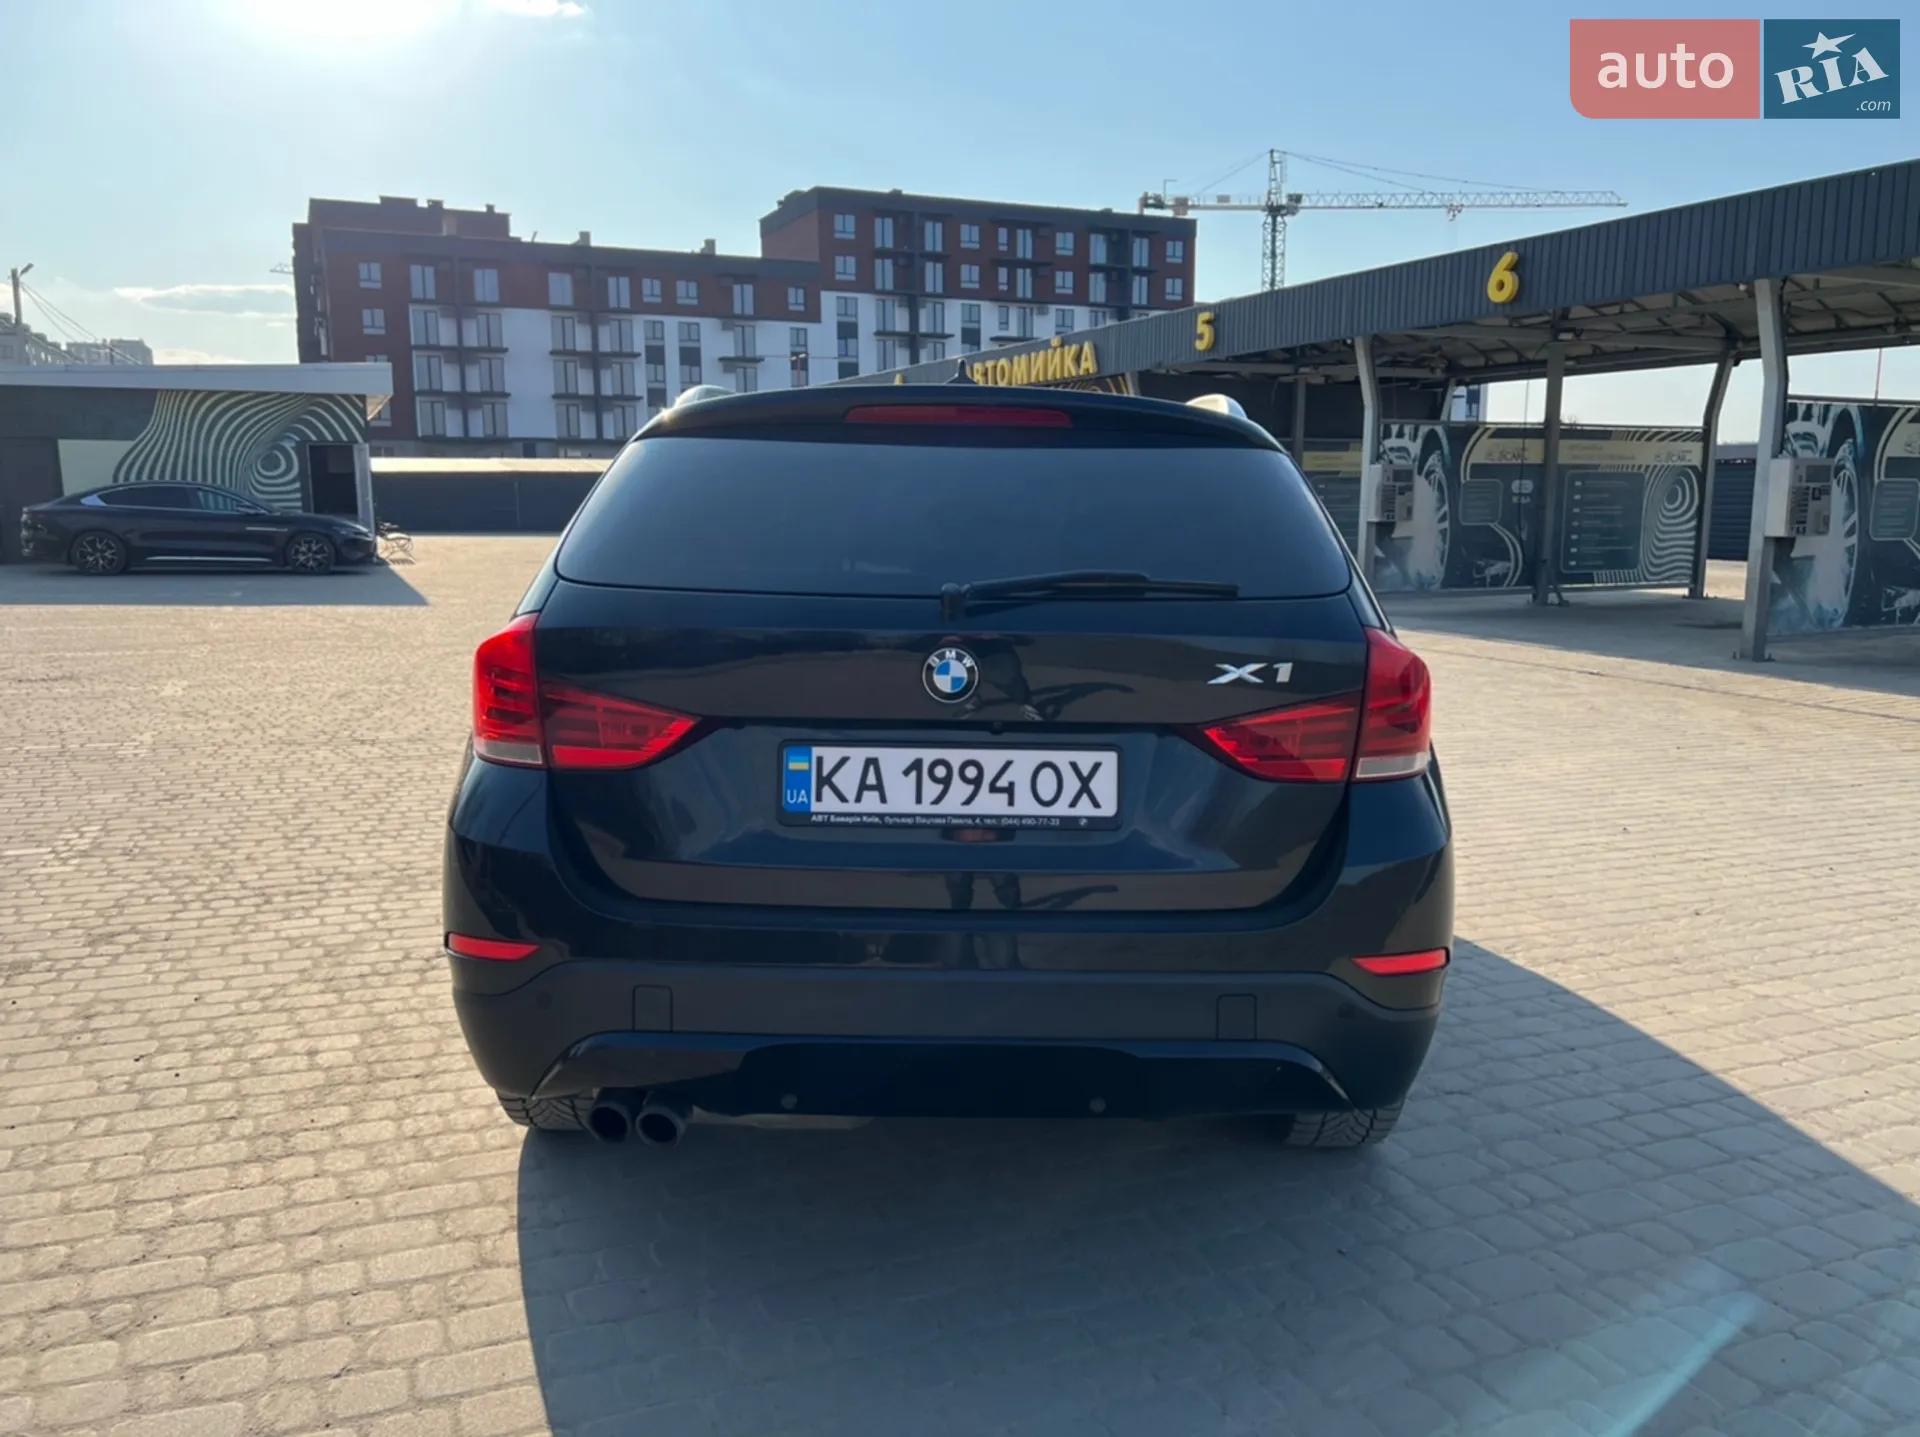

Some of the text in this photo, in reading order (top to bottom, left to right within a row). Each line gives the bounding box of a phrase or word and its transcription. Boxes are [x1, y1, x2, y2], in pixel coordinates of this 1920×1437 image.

[1486, 252, 1519, 303] 6
[1195, 311, 1215, 351] 5
[928, 649, 975, 668] BMW
[1206, 661, 1294, 685] X1
[786, 790, 809, 804] UA
[815, 756, 1104, 809] KA 1994 OX
